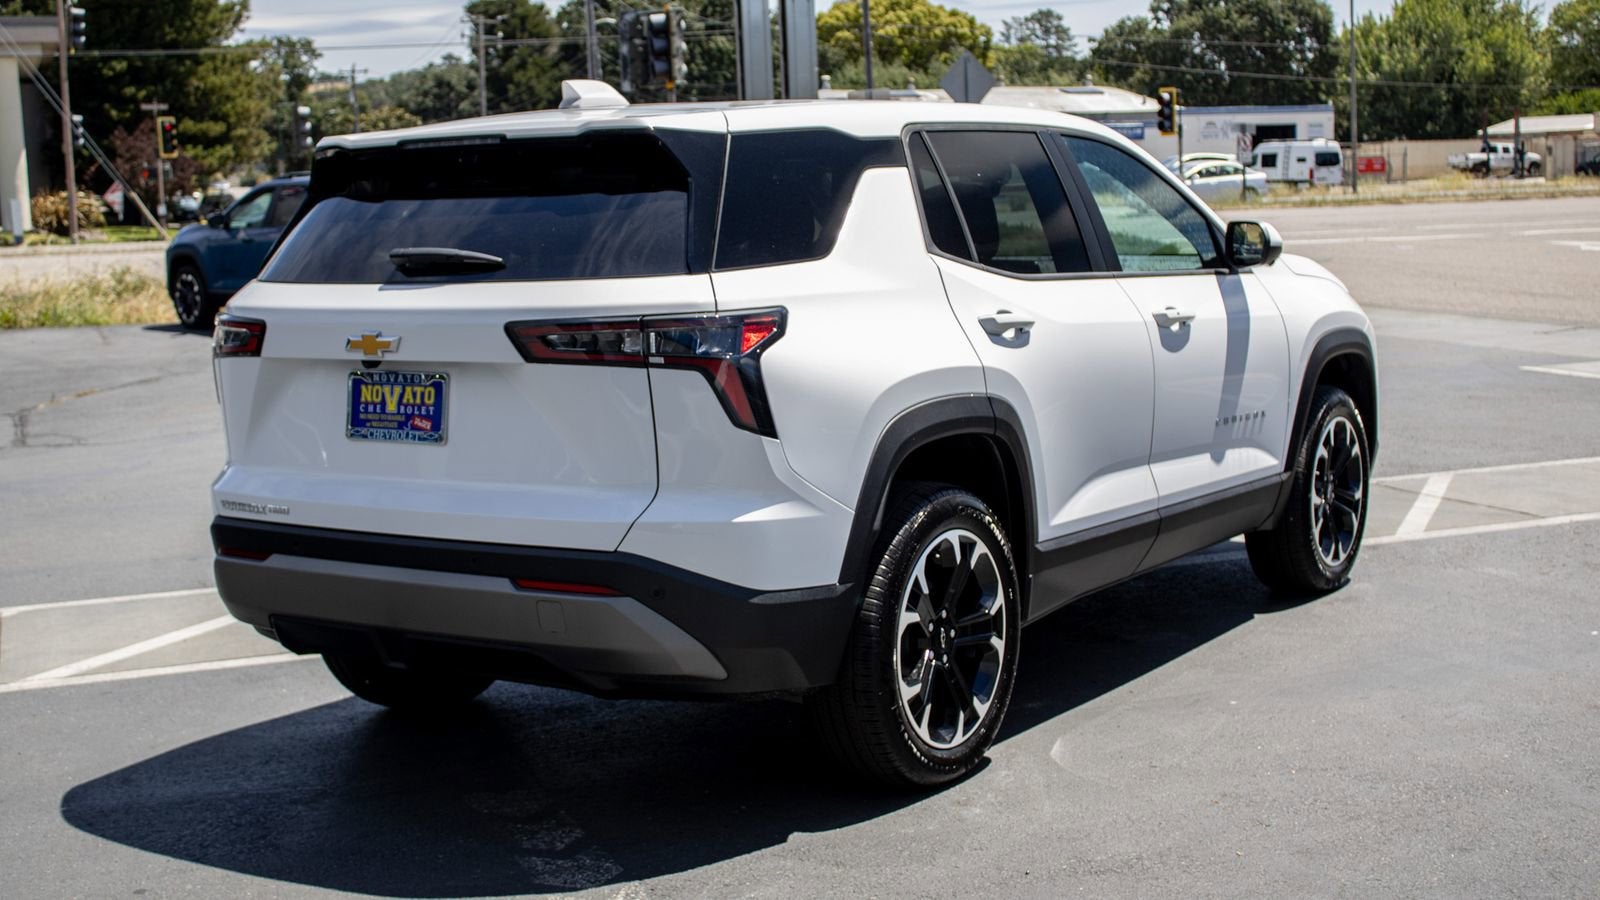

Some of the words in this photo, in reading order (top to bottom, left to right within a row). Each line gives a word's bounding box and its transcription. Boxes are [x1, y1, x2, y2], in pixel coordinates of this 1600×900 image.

[373, 373, 421, 383] NOVATO
[360, 384, 435, 413] NOVATO
[367, 429, 420, 442] CHEVROLET
